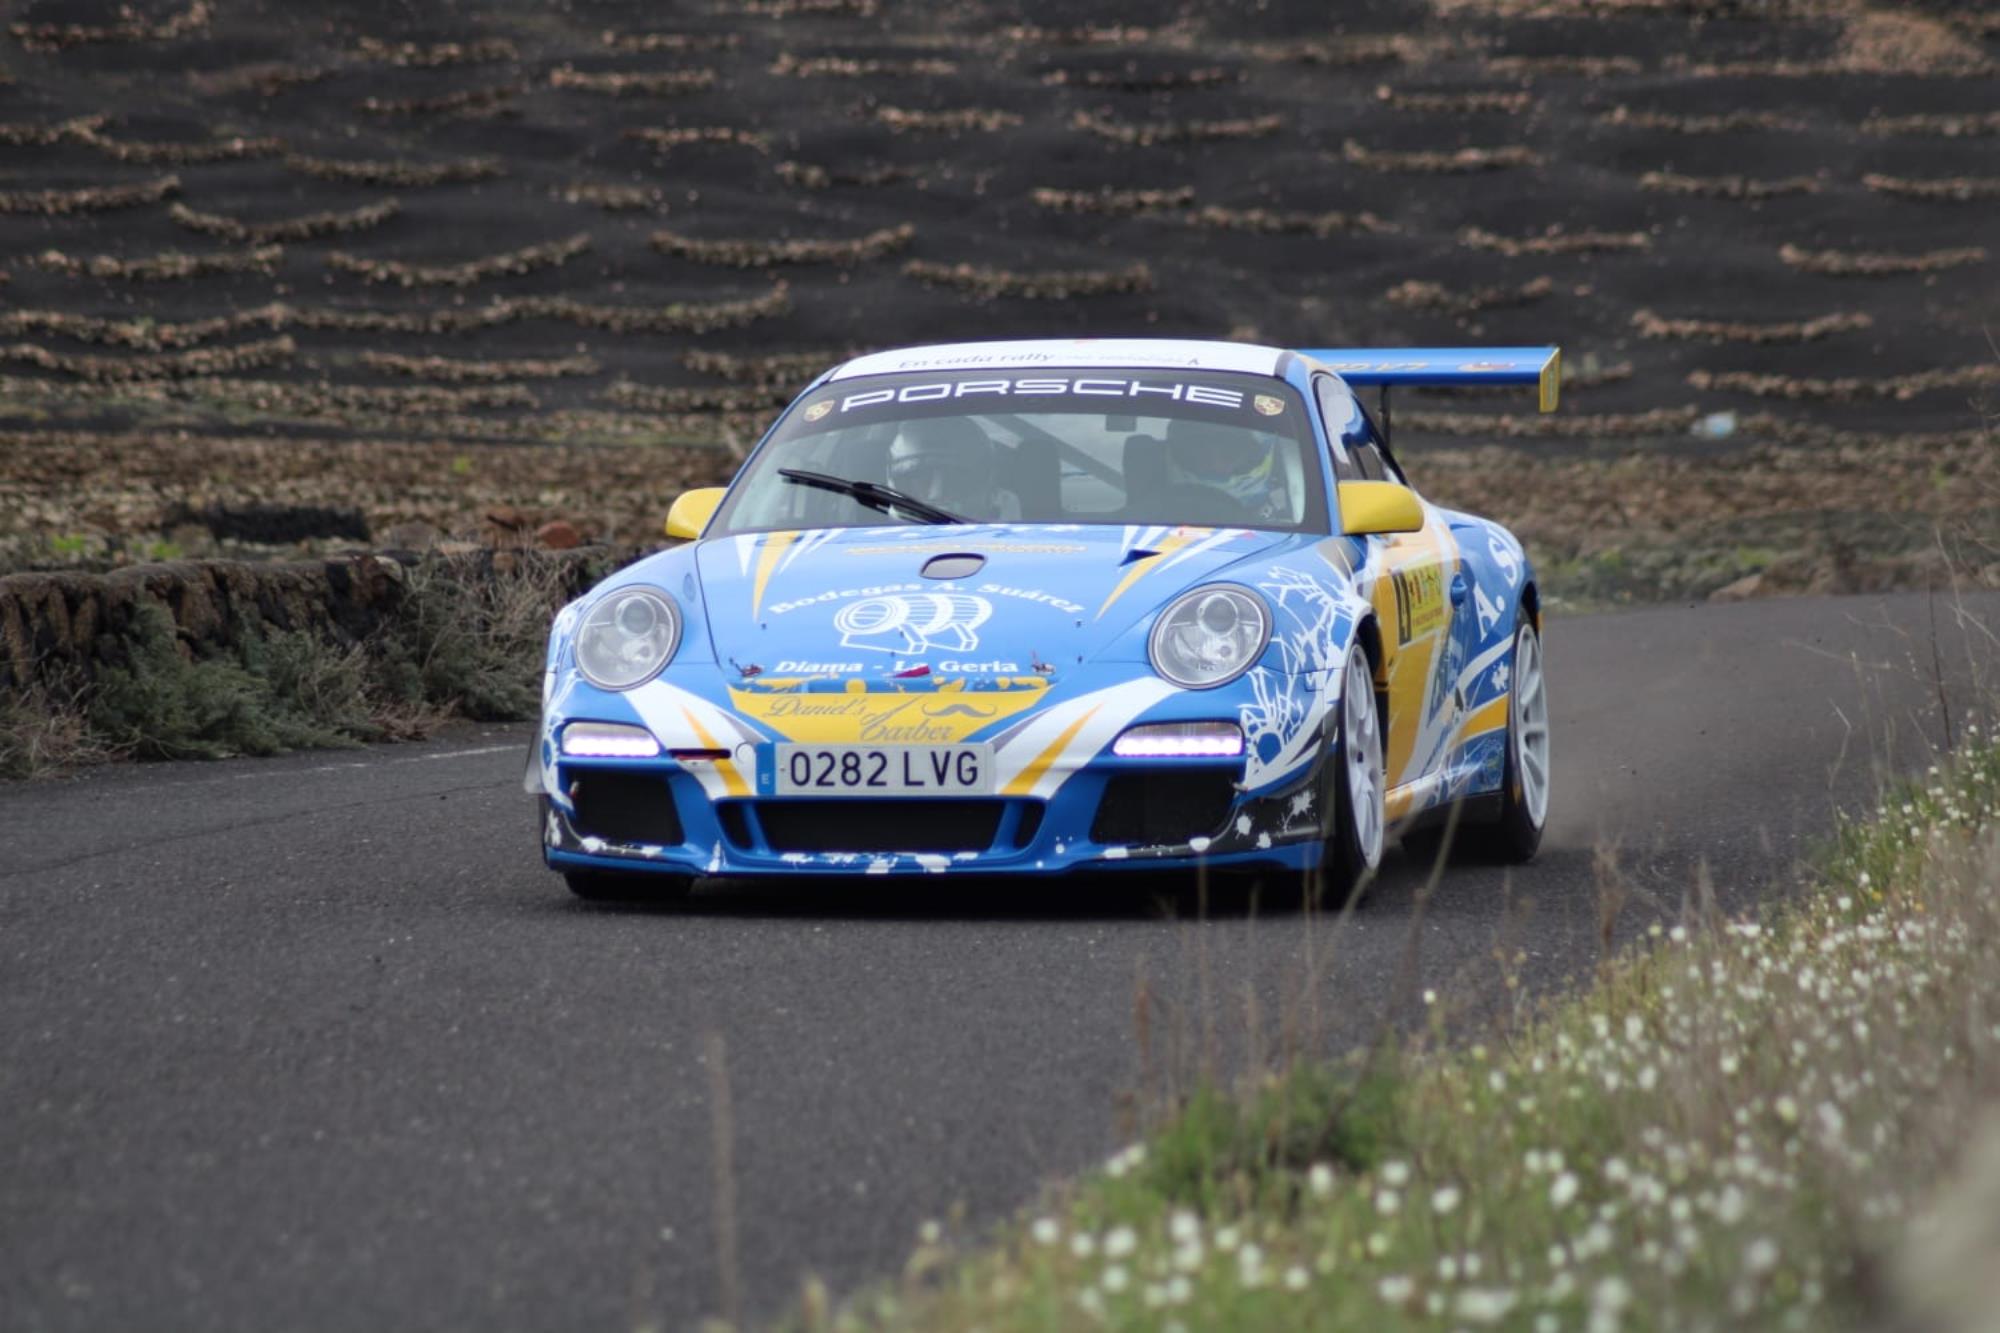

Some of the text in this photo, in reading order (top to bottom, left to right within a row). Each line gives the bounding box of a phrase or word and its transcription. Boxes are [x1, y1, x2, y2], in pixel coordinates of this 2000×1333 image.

[1000, 352, 1056, 363] rally
[841, 378, 1244, 413] PORSCHE
[767, 582, 923, 614] Bodegas
[930, 581, 965, 592] A.
[773, 661, 863, 673] Diama
[938, 660, 1019, 673] Geria
[762, 695, 866, 717] Daniel's
[790, 751, 978, 787] 0282 LVG
